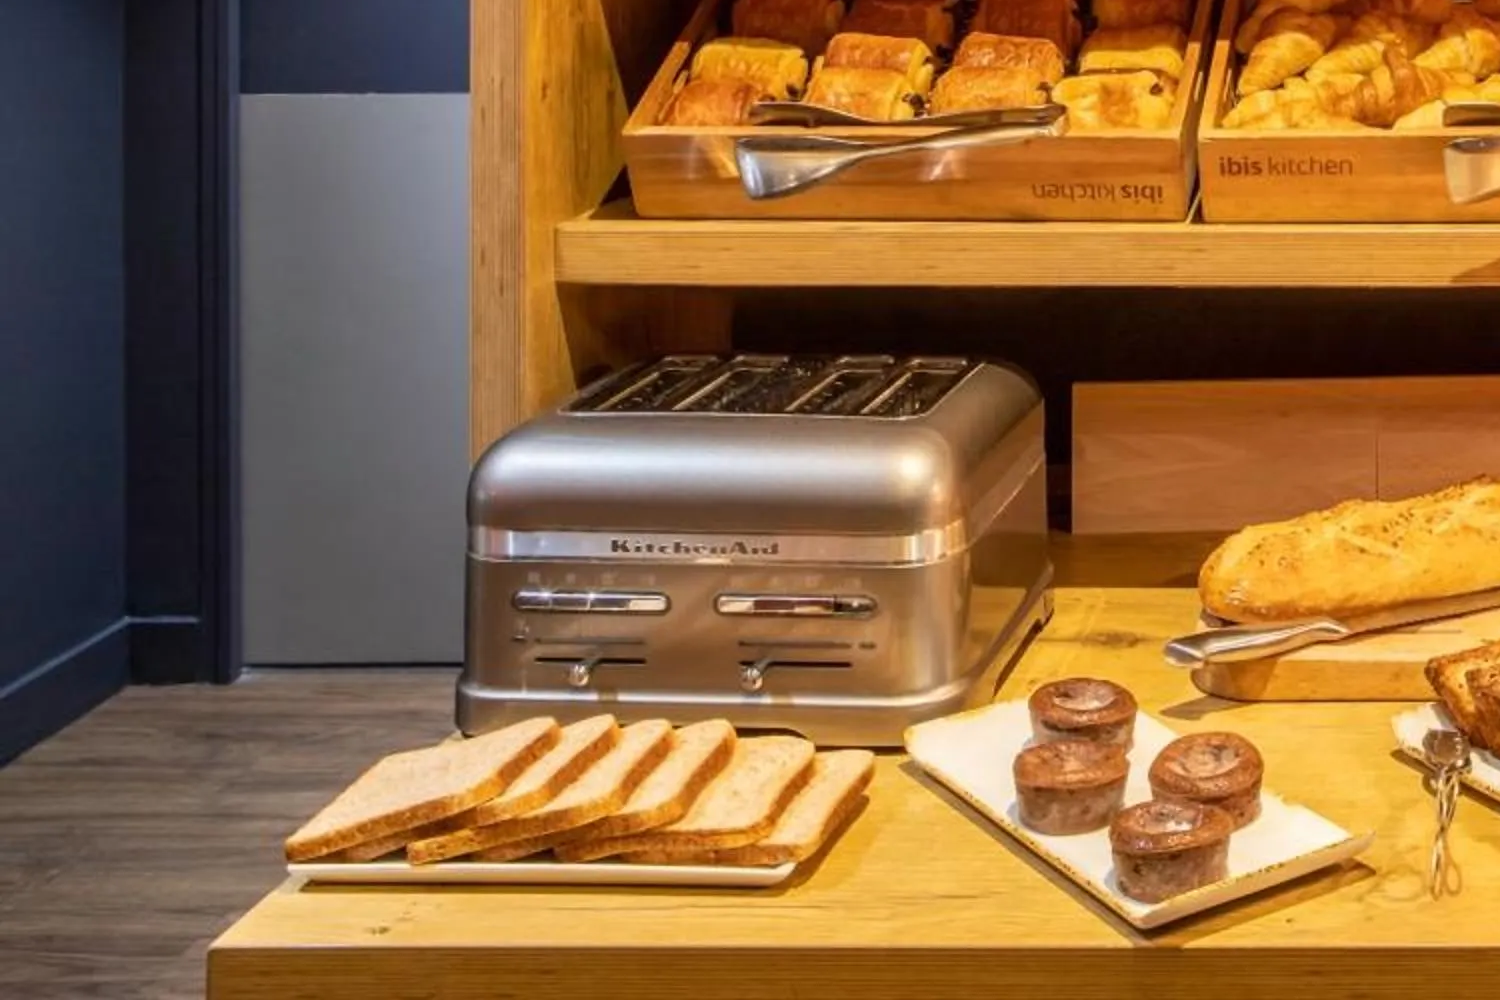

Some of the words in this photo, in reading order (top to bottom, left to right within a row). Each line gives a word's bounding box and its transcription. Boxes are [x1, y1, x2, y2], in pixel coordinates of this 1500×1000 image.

[1219, 157, 1263, 176] ibis
[1267, 155, 1354, 176] kitchen
[1032, 183, 1116, 202] kitchen
[1120, 184, 1163, 202] ibis
[610, 539, 780, 556] KitchenAid
